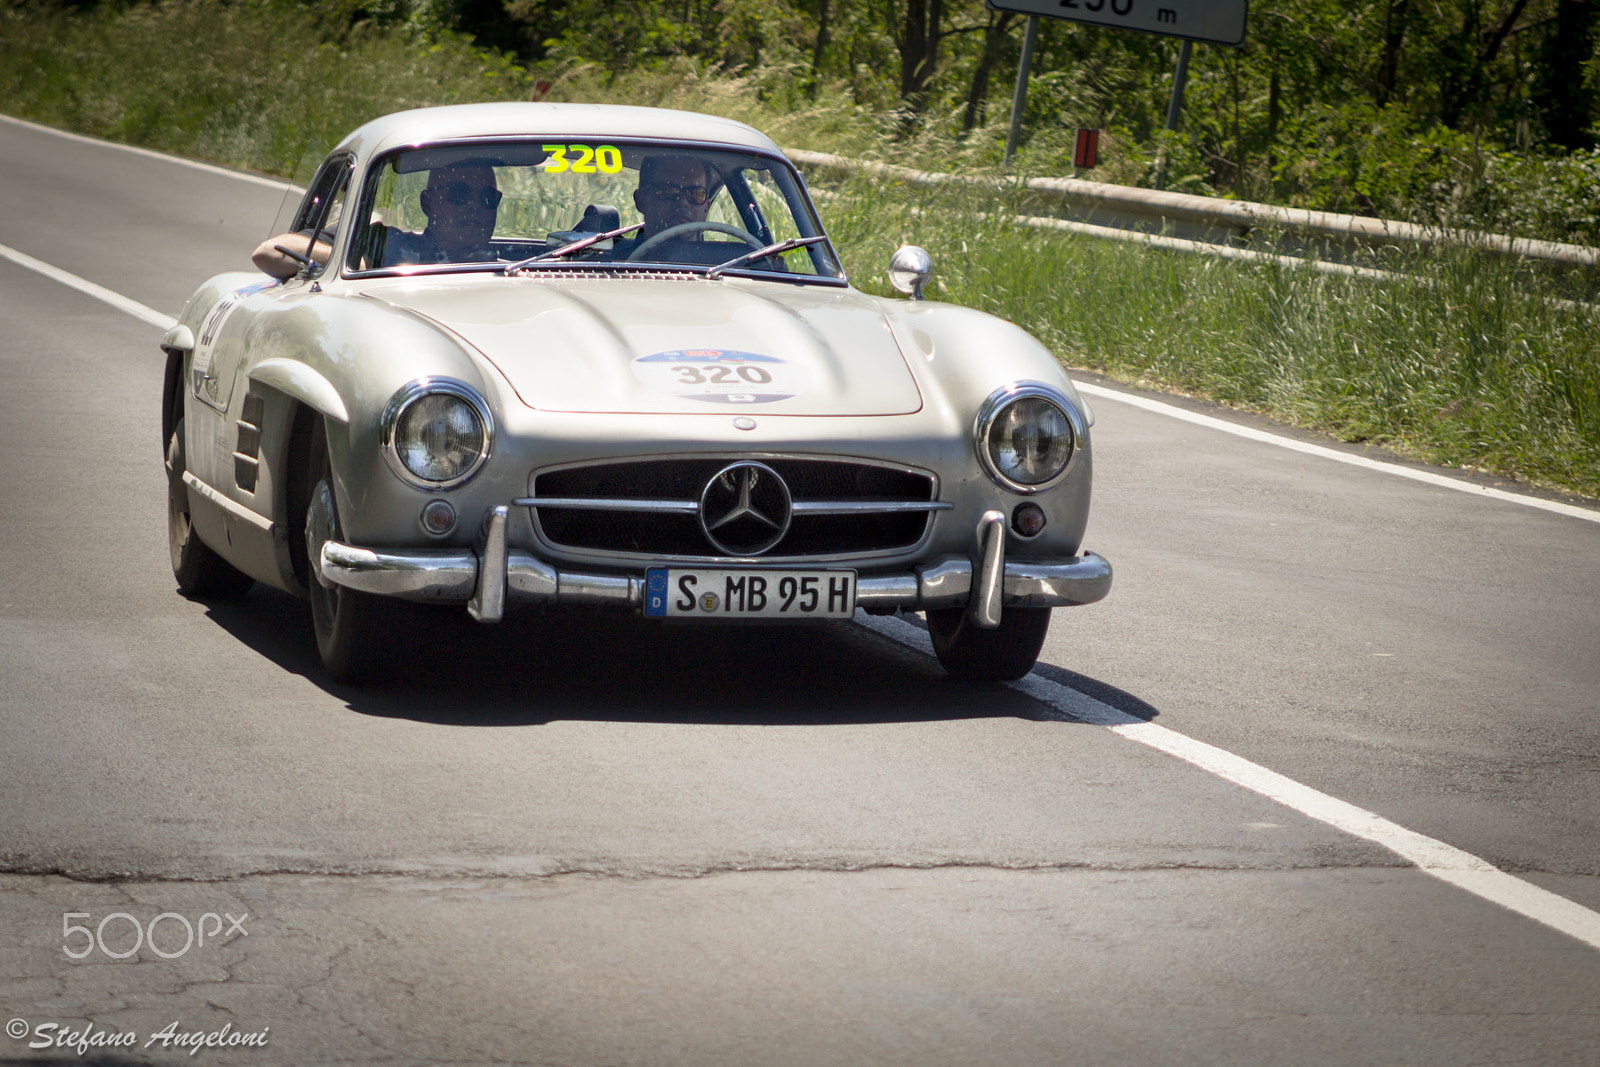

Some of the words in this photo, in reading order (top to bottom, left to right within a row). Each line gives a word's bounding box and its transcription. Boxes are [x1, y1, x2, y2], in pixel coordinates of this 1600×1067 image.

[1156, 7, 1178, 25] m
[541, 144, 623, 174] 320
[670, 364, 773, 385] 320
[652, 596, 661, 609] D
[676, 574, 698, 613] S
[724, 575, 768, 613] MB
